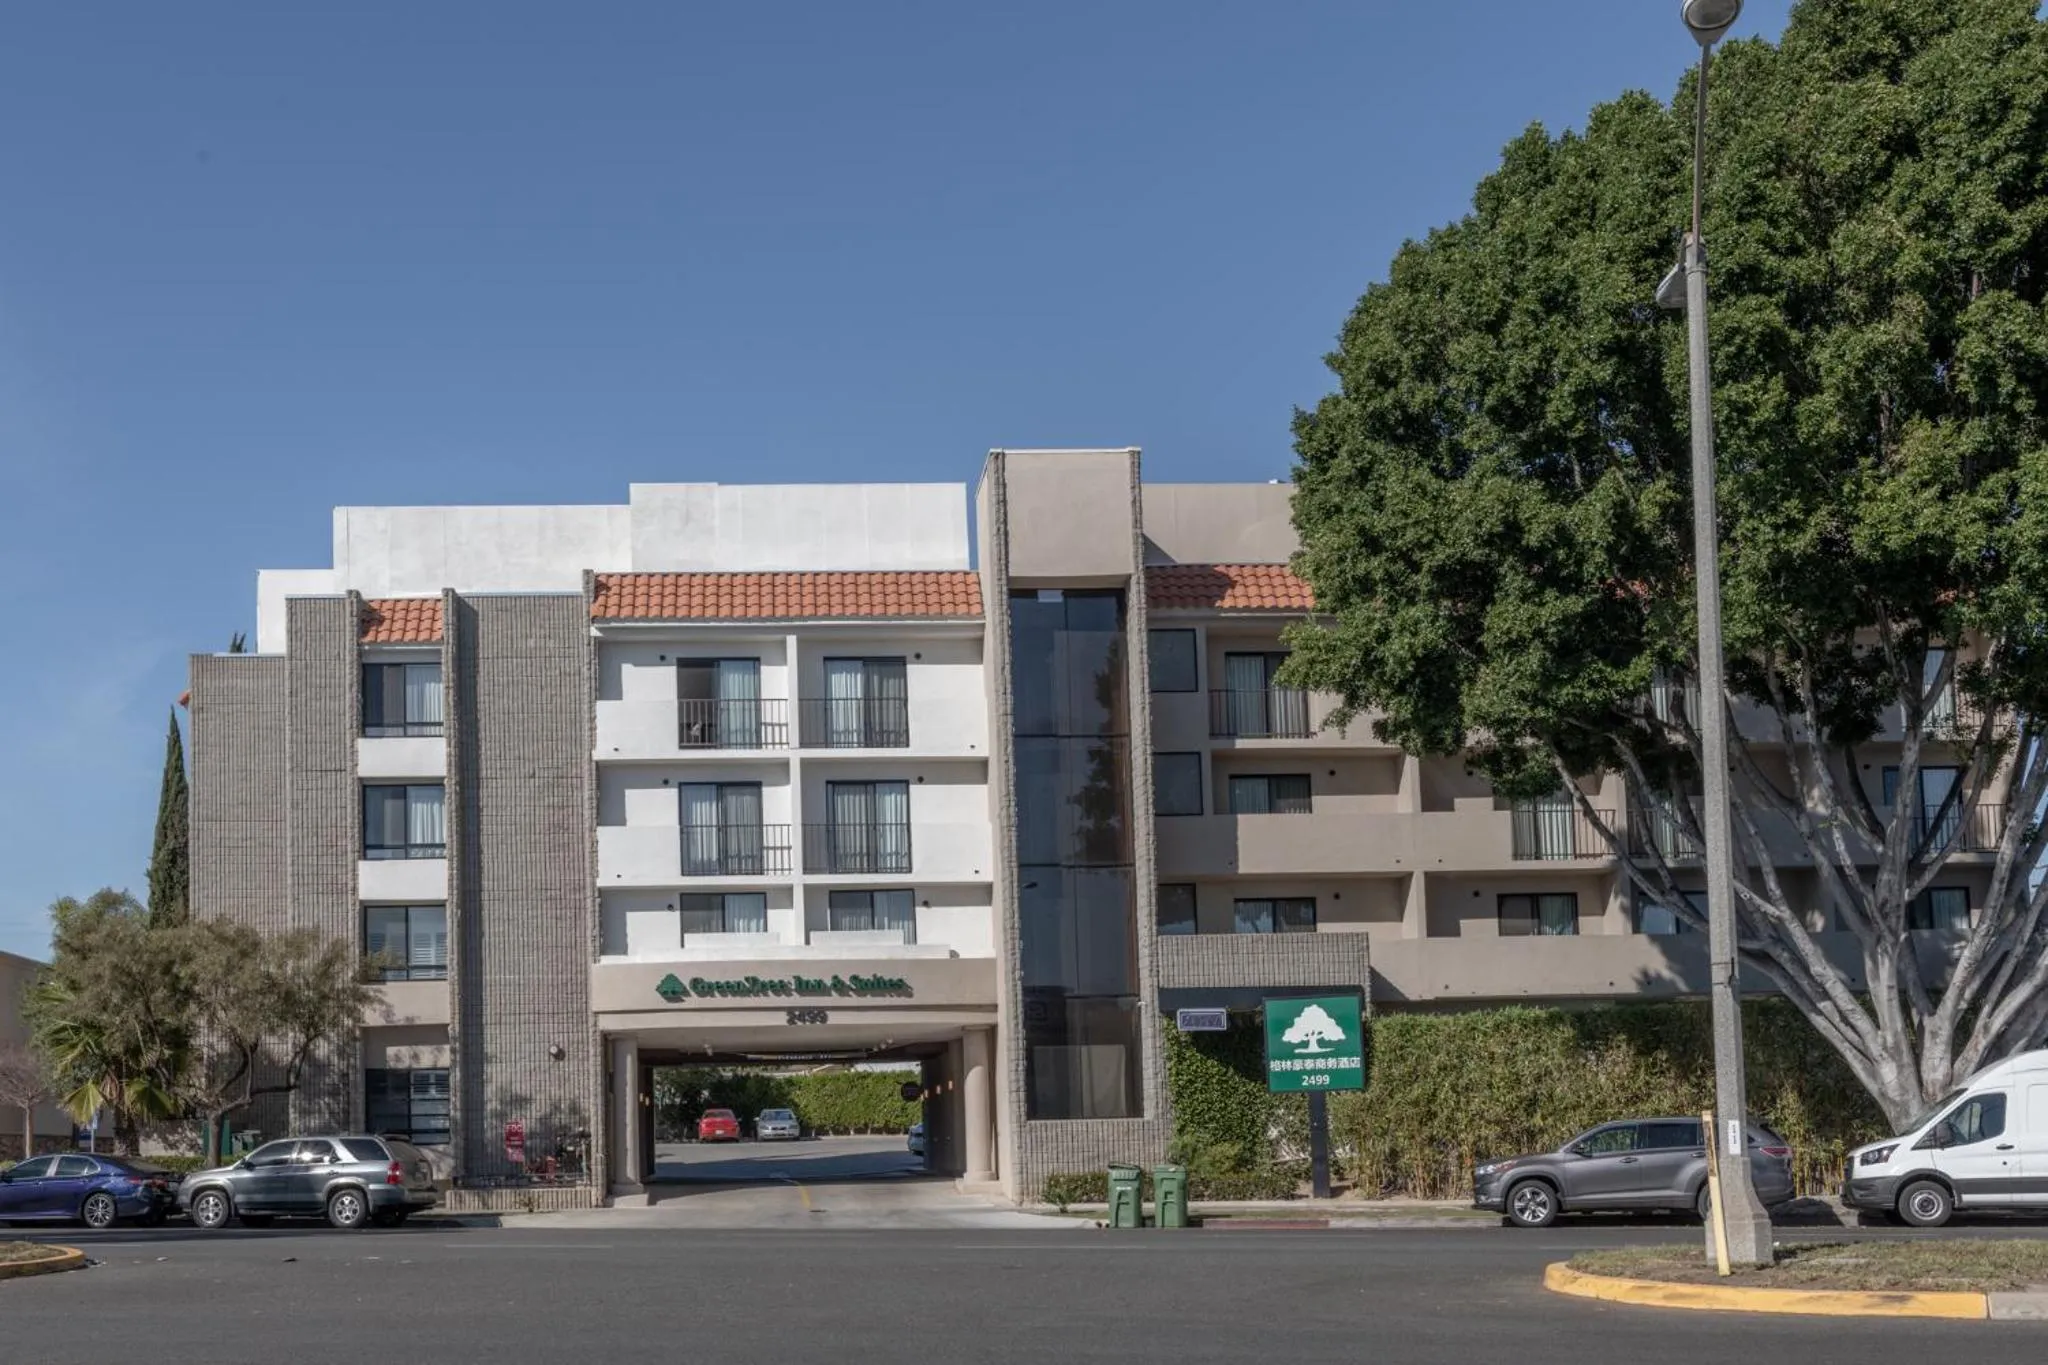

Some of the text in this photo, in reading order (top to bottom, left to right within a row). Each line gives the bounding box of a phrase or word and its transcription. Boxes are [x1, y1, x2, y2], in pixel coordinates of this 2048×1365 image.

[689, 973, 905, 992] GreenTree Inn & Suites
[786, 1008, 828, 1025] 2499
[1301, 1074, 1330, 1086] 2499
